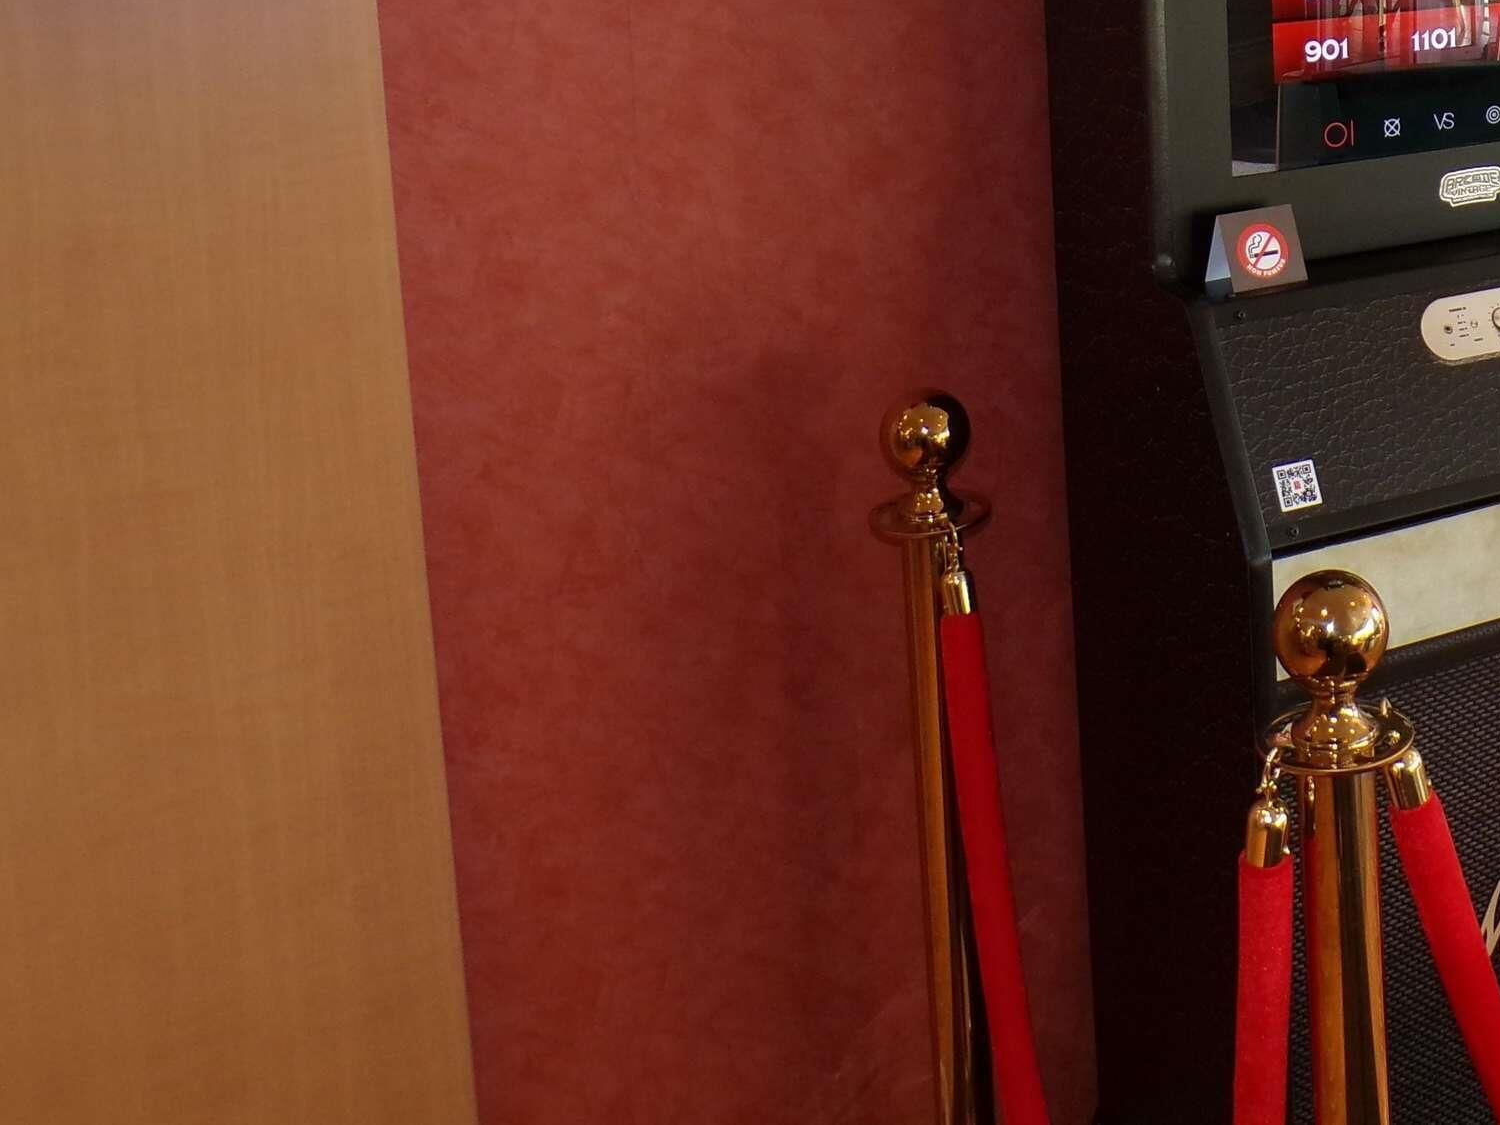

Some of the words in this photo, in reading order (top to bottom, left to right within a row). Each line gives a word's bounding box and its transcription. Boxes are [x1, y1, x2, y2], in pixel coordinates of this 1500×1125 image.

[1411, 27, 1456, 52] 1101
[1304, 40, 1349, 62] 901
[1433, 112, 1456, 131] VS
